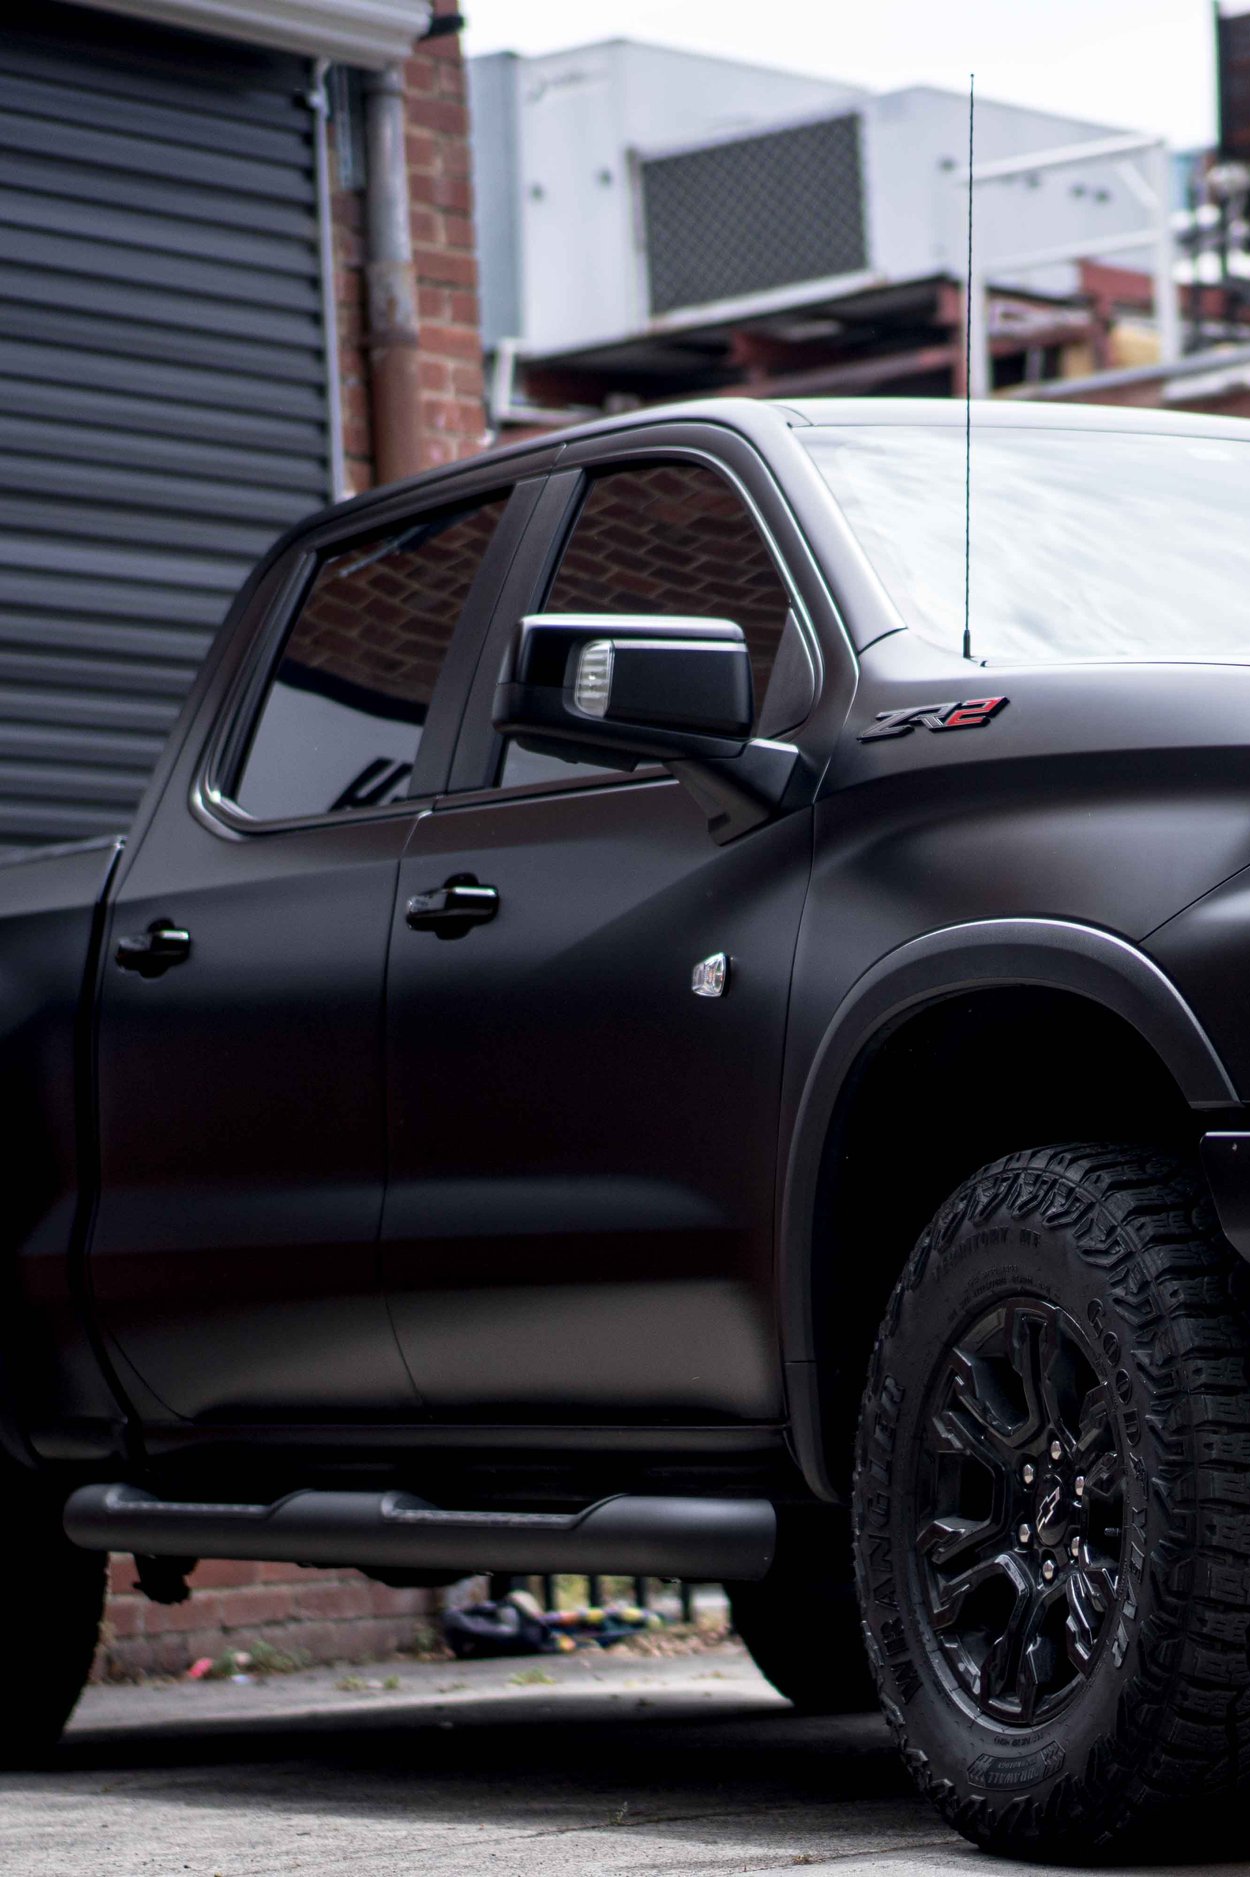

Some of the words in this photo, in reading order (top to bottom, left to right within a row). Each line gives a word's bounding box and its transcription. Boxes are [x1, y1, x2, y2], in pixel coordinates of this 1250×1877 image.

[857, 697, 1010, 743] ZR2
[866, 1373, 922, 1706] WRANGLER
[1087, 1298, 1149, 1669] GOODYEAR
[987, 1767, 1040, 1784] DURAWALL
